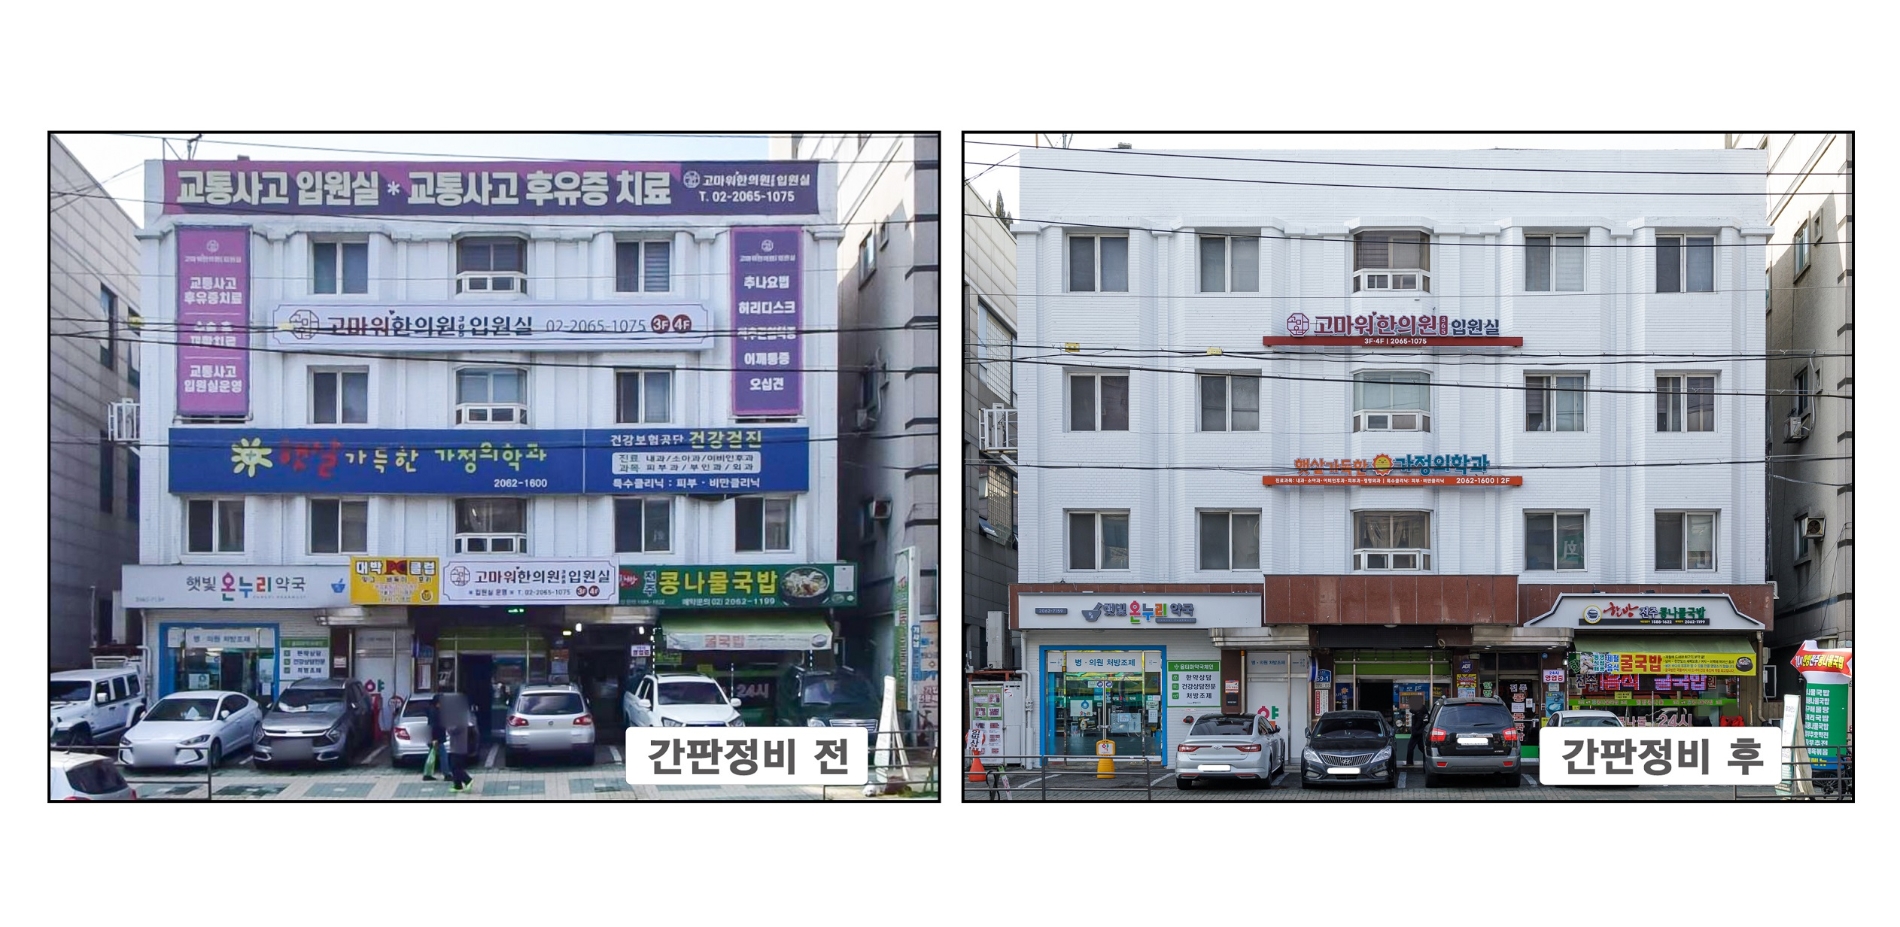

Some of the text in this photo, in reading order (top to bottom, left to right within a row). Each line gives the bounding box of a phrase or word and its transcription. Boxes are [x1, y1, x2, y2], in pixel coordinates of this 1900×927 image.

[177, 170, 672, 206] 교통사고 입원실 교통사고 후유증 치료
[712, 191, 795, 204] 02-2065-1075
[190, 277, 237, 290] 교통사고
[744, 276, 790, 289] 추나요법
[184, 292, 243, 305] 후유증치료
[738, 301, 796, 315] 허리디스크
[328, 315, 456, 337] 고마워한의원
[470, 316, 532, 337] 입원실
[546, 319, 646, 333] 02-2065-1075
[652, 318, 669, 331] 3F
[673, 318, 691, 331] 4F
[1314, 315, 1500, 337] 고마워한의원 365 입원실
[744, 352, 791, 366] 어깨통증
[190, 365, 237, 378] 교통사고
[184, 380, 243, 393] 입원실운영
[749, 377, 785, 391] 오십견
[611, 430, 762, 450] 건강보험공단 건강검진
[345, 446, 419, 474] 가득한
[434, 441, 549, 474] 가정의학과
[619, 454, 640, 463] 진료
[1394, 454, 1490, 475] 가정의학과
[494, 477, 548, 489] 2062-1600
[612, 479, 666, 490] 특수클리닉
[676, 479, 698, 490] 피부
[709, 478, 761, 489] 비만클리닉
[356, 559, 437, 576] 대박 PC 클럽
[475, 569, 560, 585] 고마워한의원
[568, 569, 611, 584] 입원실
[643, 570, 657, 598] 전주
[658, 571, 778, 595] 콩나물국밥
[186, 572, 306, 602] 햇빛 온누리 약국
[525, 588, 571, 597] 02-2065-1075
[725, 598, 776, 606] 2062-1199
[1103, 601, 1195, 624] 햇빛 온누리 약국
[1640, 606, 1659, 619] 전주
[1659, 606, 1706, 619] 콩나물국밥
[1106, 658, 1136, 667] 처방조제
[1621, 654, 1663, 673] 굴국밥
[1186, 674, 1212, 682] 한약상담
[736, 684, 770, 699] 24시
[1181, 683, 1217, 691] 건강상담전문
[1186, 692, 1213, 700] 처방조제
[1659, 713, 1693, 727] 24시
